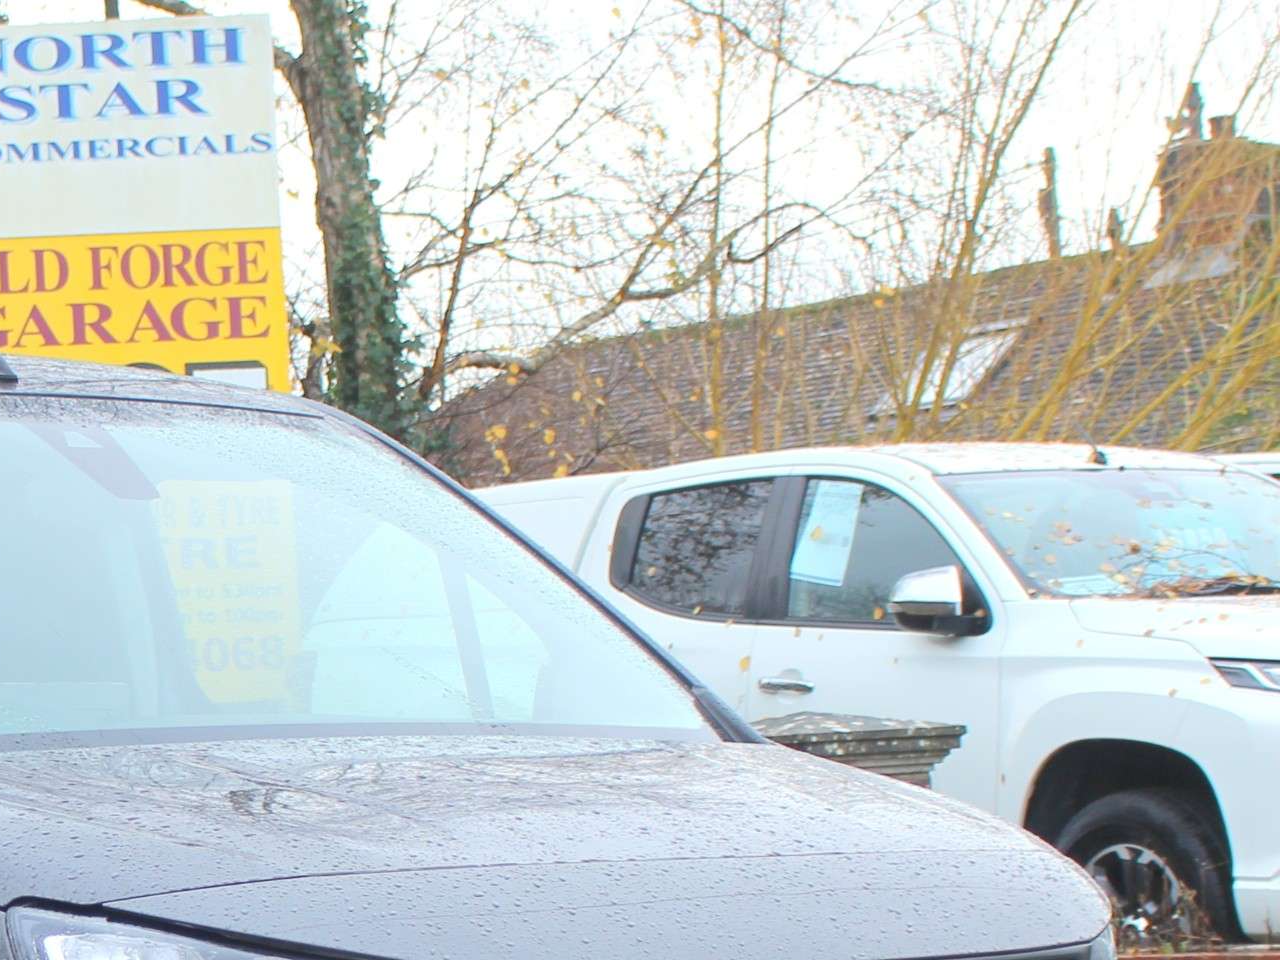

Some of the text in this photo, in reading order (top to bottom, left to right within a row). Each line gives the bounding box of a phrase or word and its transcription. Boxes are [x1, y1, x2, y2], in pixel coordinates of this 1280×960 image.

[87, 240, 269, 291] FORGE
[170, 534, 263, 570] RE
[192, 634, 287, 671] 068
